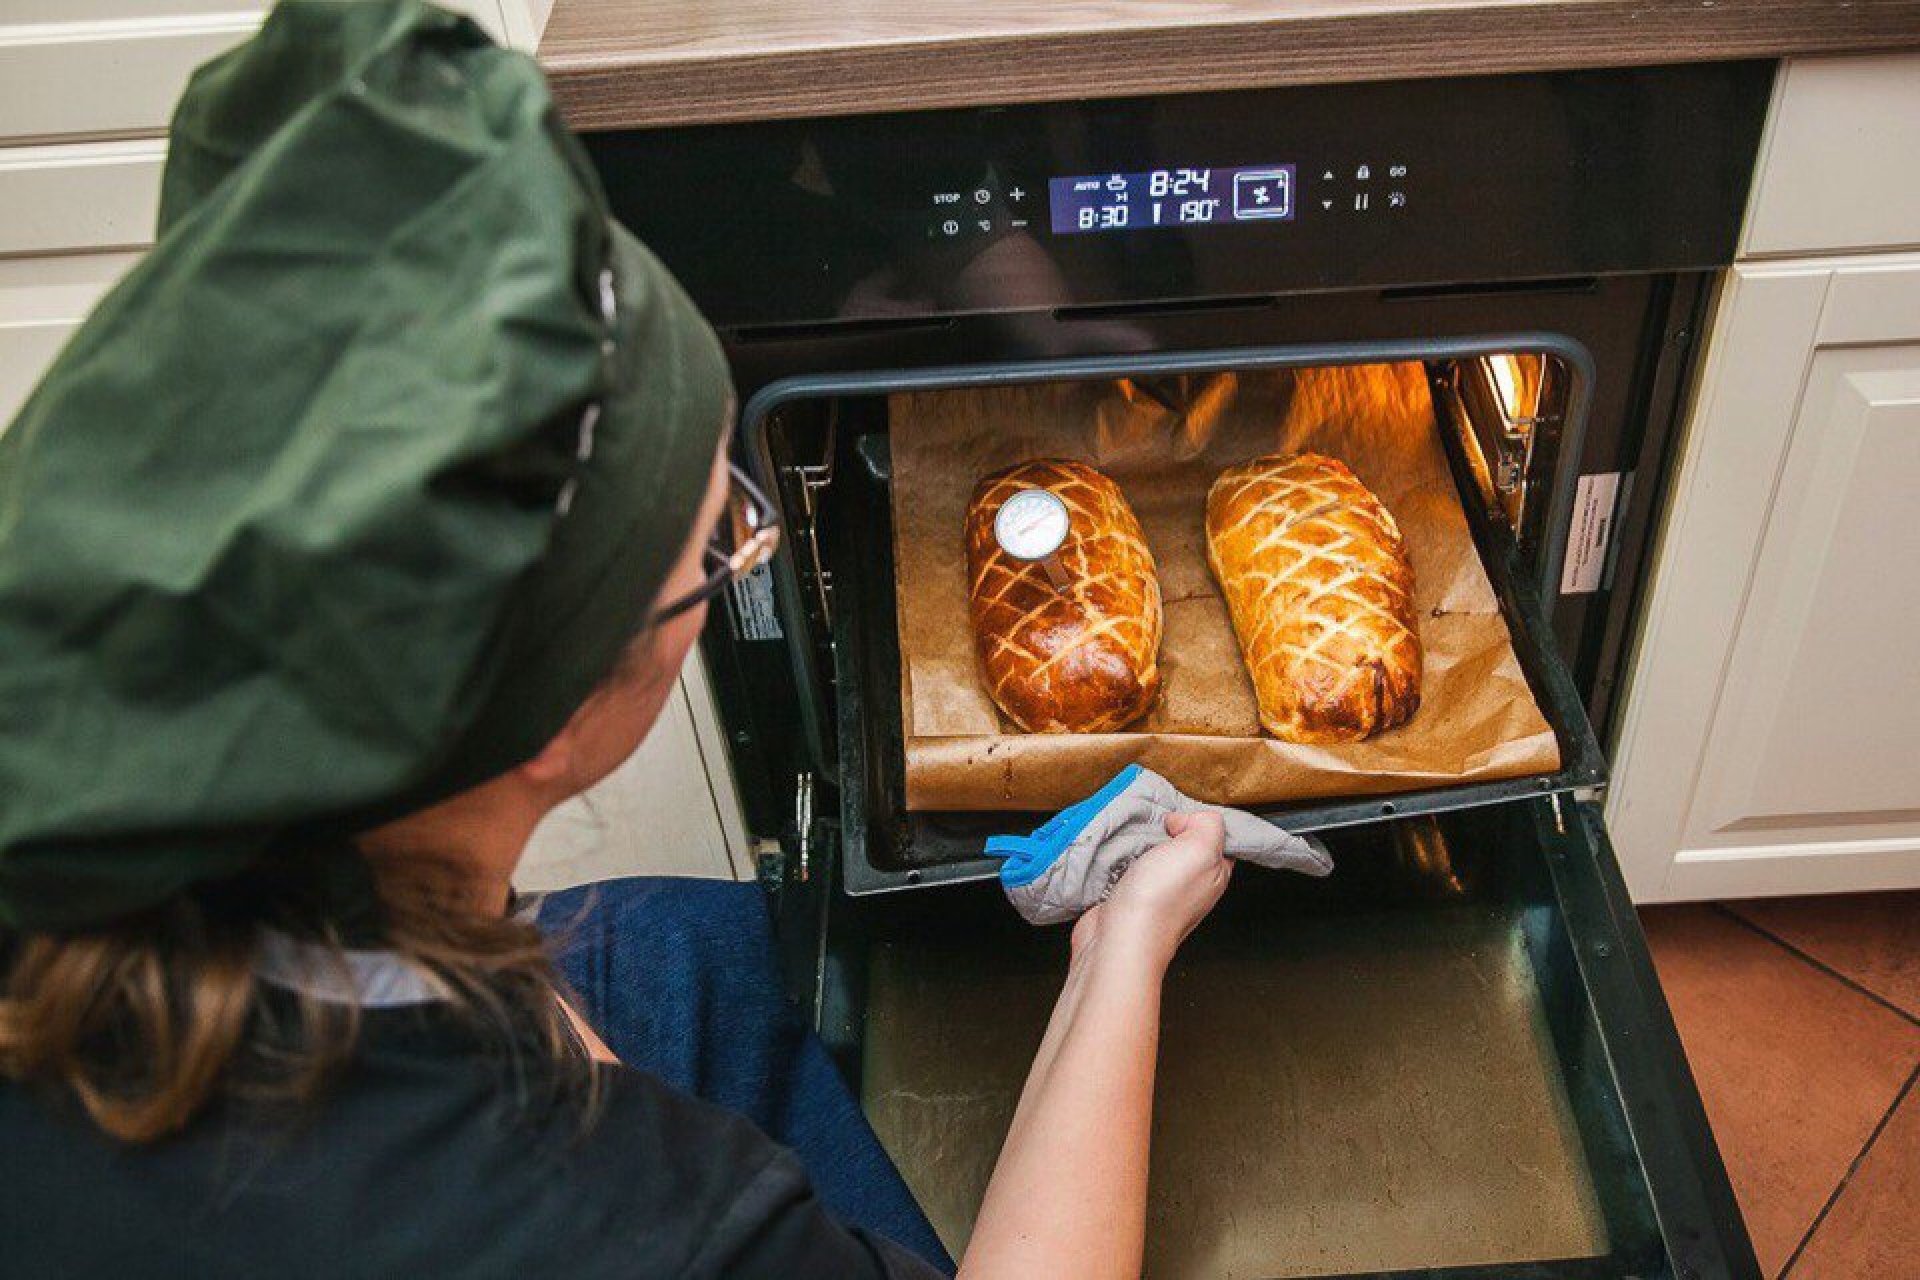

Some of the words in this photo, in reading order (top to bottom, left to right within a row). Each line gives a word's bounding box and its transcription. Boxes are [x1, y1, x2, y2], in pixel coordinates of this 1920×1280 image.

[1150, 169, 1211, 197] 8:24
[932, 193, 961, 205] STOP
[1078, 205, 1129, 231] 8:30
